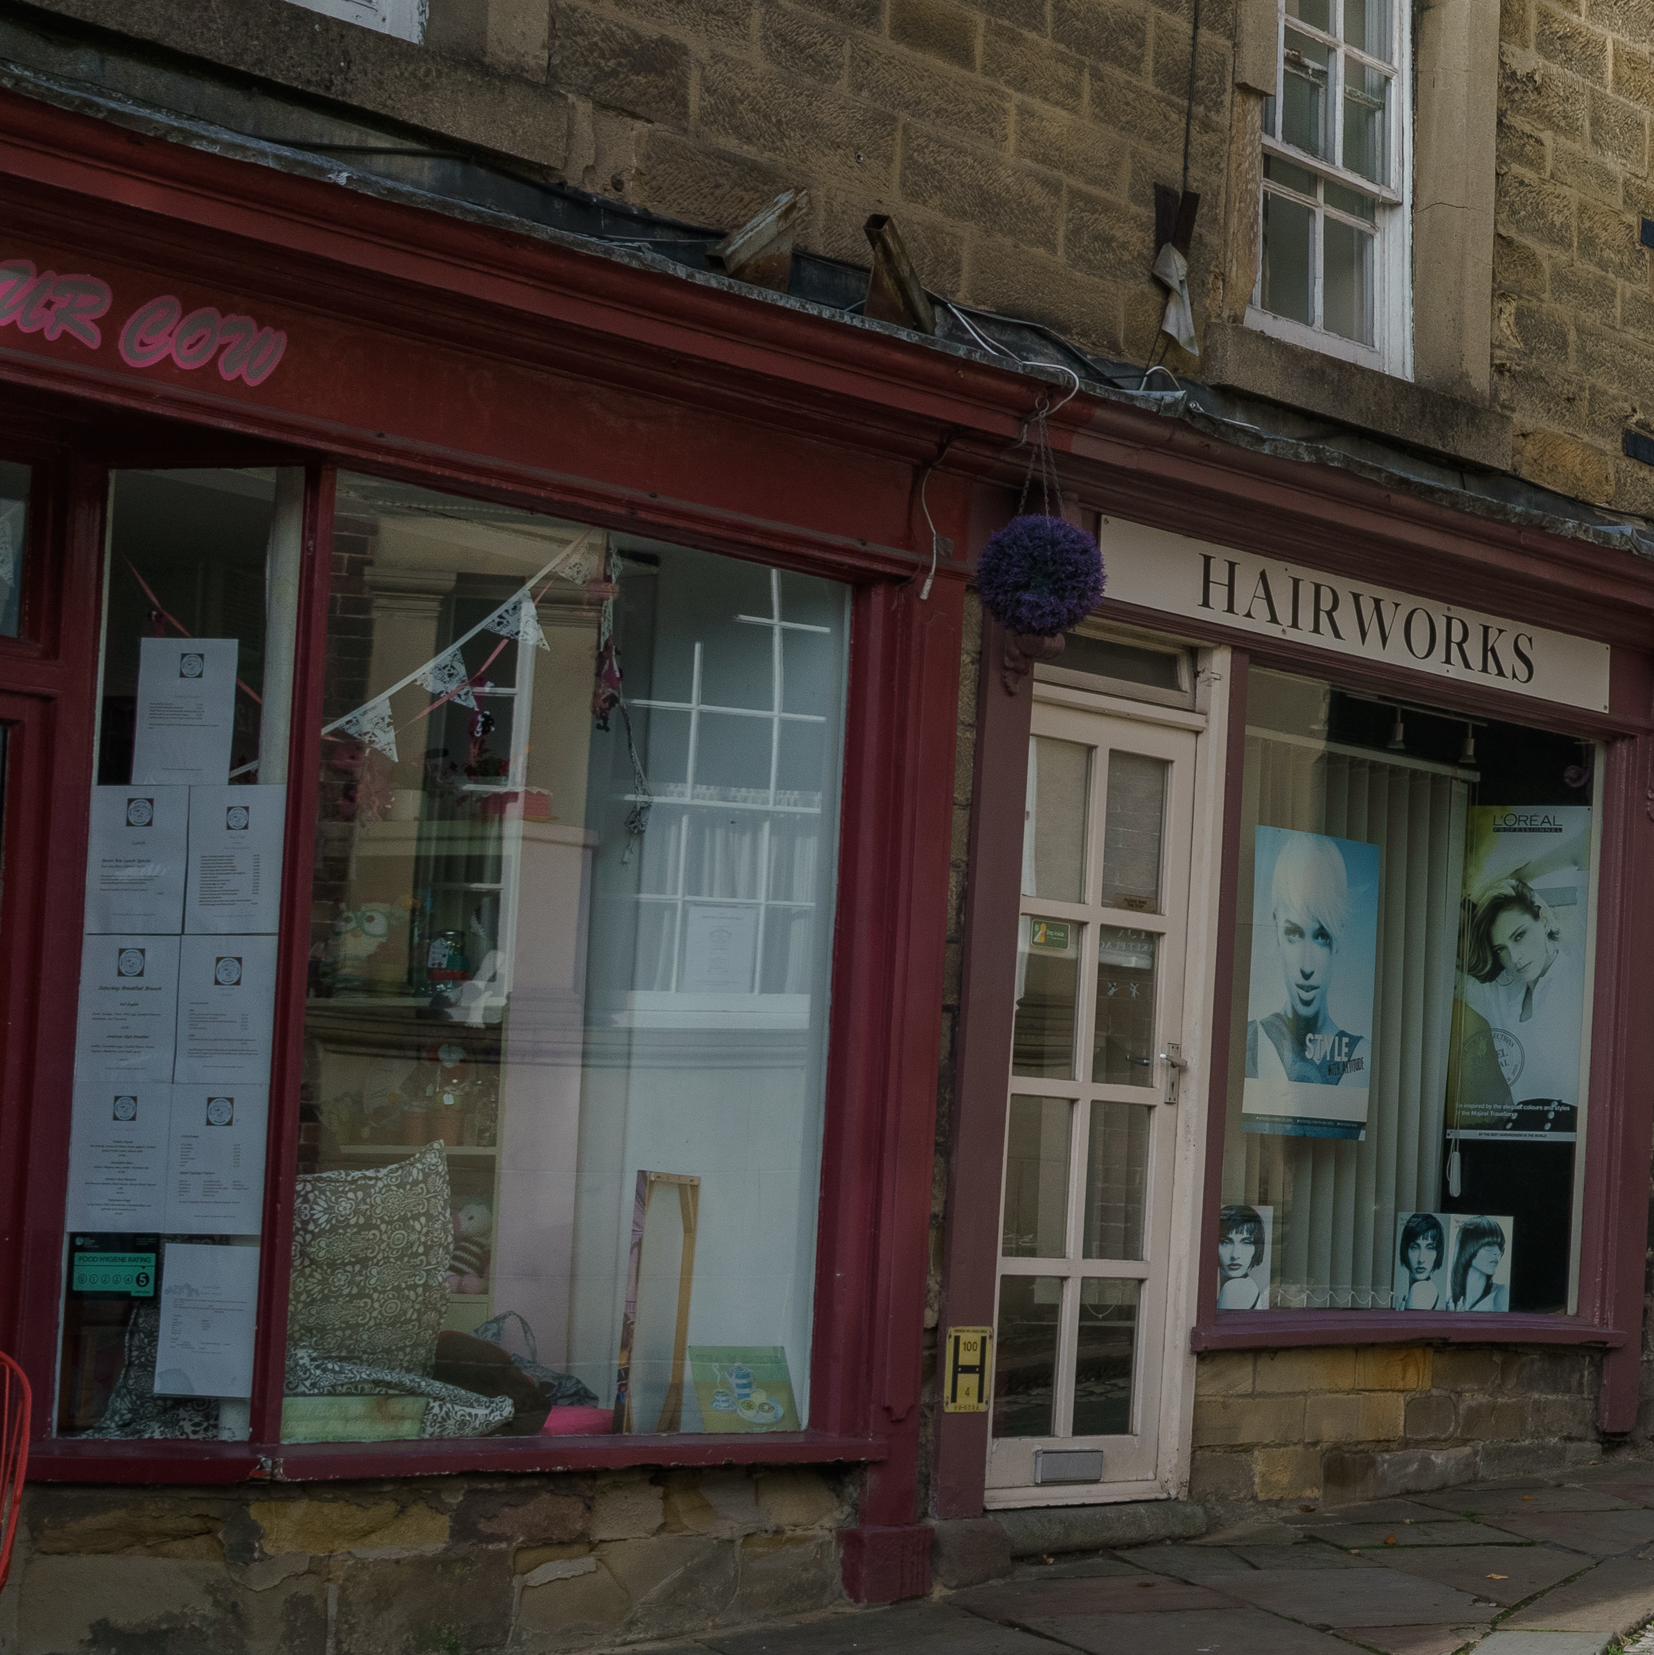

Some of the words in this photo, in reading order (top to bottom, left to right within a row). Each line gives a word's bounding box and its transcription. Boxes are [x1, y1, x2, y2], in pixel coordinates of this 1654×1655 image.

[0, 259, 113, 350] UR
[118, 294, 288, 387] COW
[1198, 553, 1535, 684] HAIRWORKS
[1493, 813, 1563, 827] L'ORÉAL
[1305, 1033, 1350, 1065] STYLE
[1341, 1057, 1365, 1075] ATTITUDE
[128, 1256, 152, 1264] RATING
[139, 1274, 147, 1286] 5
[963, 1341, 978, 1352] 100
[965, 1387, 971, 1397] 4
